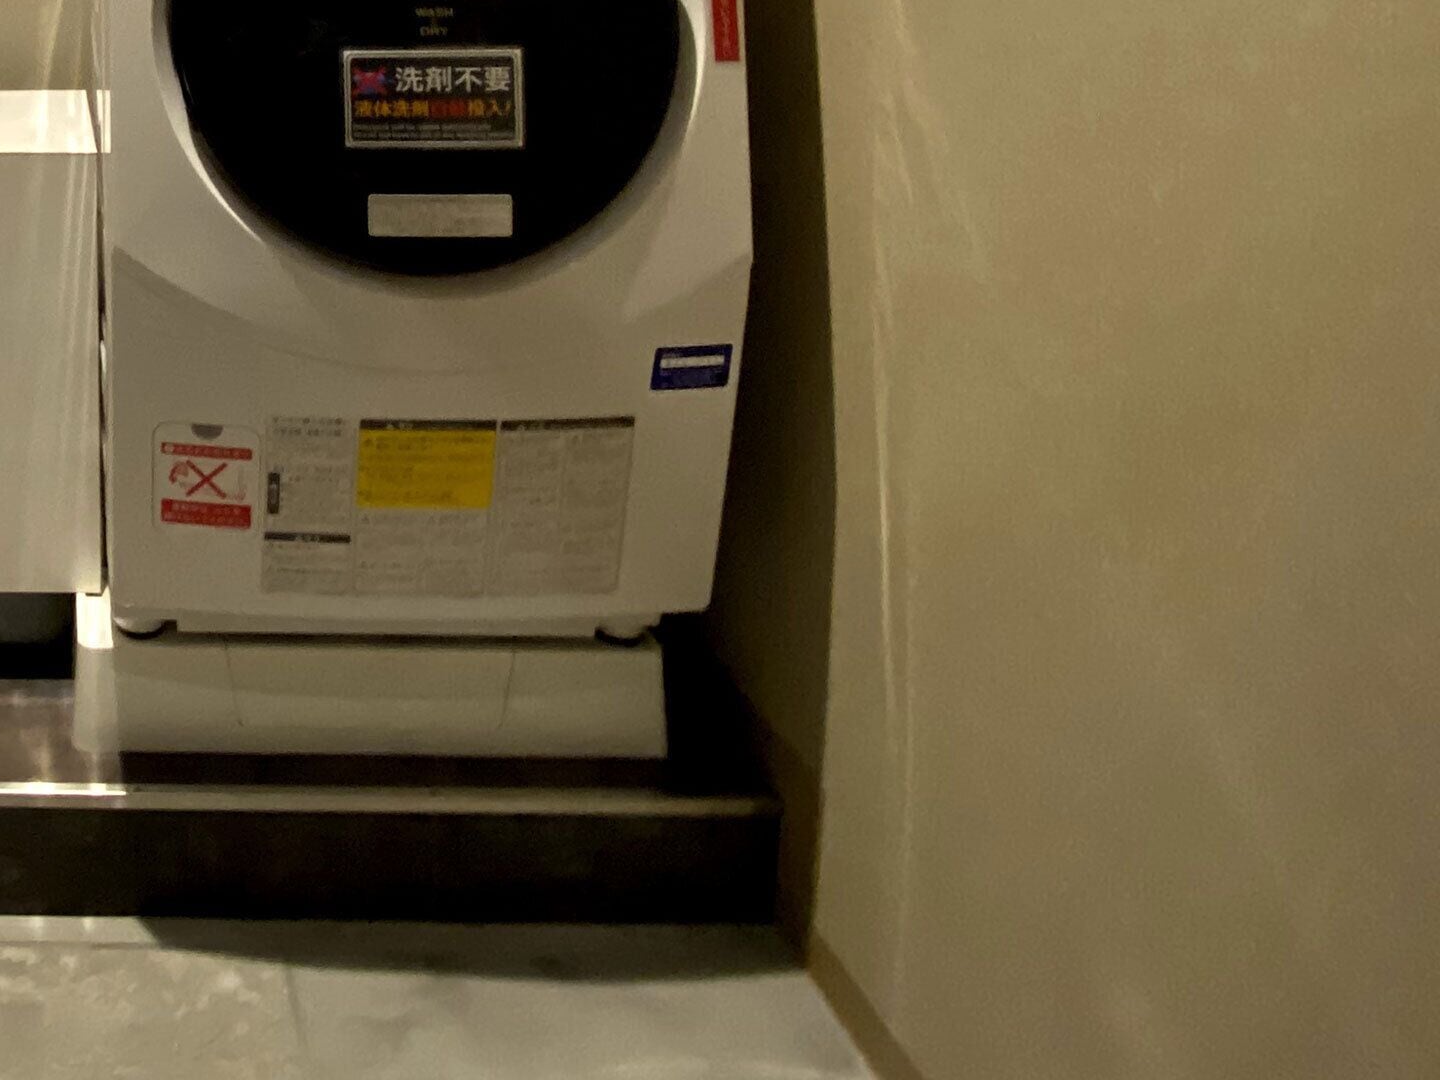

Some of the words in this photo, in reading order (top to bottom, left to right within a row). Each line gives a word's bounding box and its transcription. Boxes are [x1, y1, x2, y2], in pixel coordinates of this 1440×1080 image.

[415, 8, 453, 17] WASH
[420, 27, 448, 36] DRY
[394, 66, 511, 92] 洗剤不要
